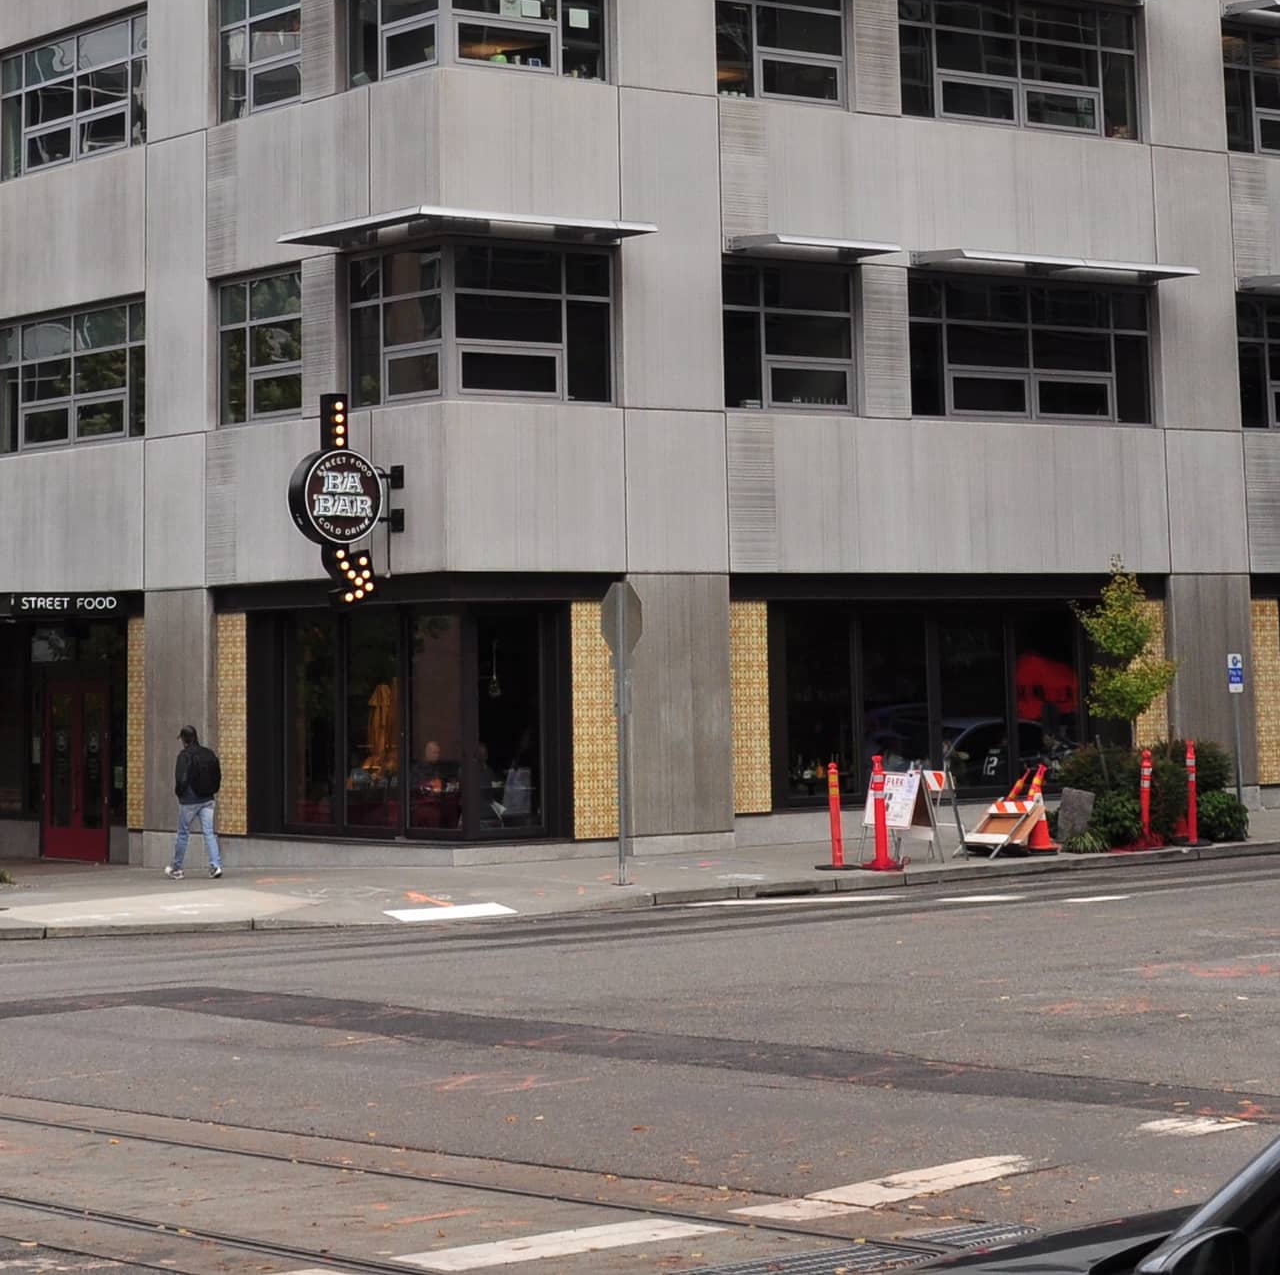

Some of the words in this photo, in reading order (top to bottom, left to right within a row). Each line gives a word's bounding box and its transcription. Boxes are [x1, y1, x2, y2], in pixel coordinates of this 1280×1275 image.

[316, 456, 346, 477] STREET
[350, 457, 372, 477] FOOD
[322, 470, 364, 494] BA
[313, 493, 373, 517] BAR
[318, 517, 342, 536] COLD
[21, 596, 71, 610] STREET
[76, 596, 118, 610] FOOD
